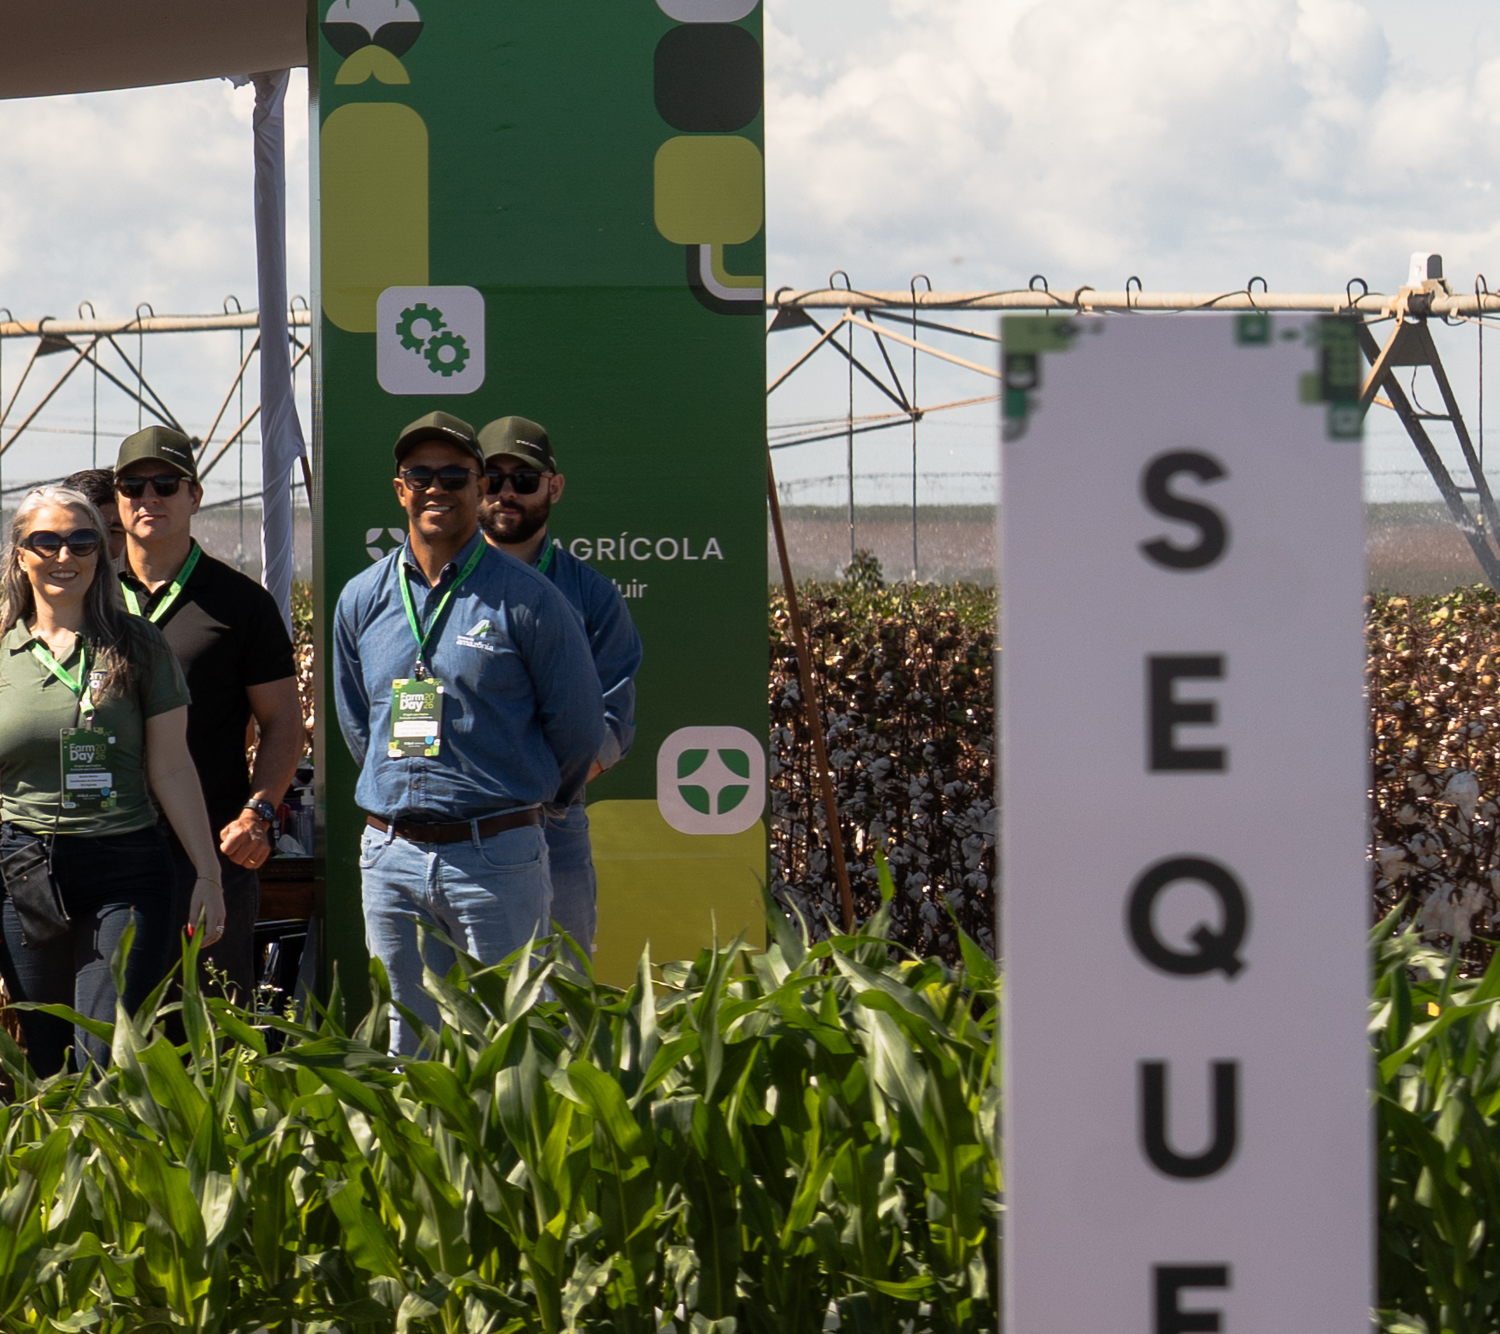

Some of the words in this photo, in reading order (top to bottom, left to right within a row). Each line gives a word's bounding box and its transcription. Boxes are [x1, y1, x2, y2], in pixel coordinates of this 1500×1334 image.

[400, 693, 424, 701] Farm
[400, 700, 424, 712] Day
[70, 743, 95, 752] Farm
[70, 750, 95, 763] Day
